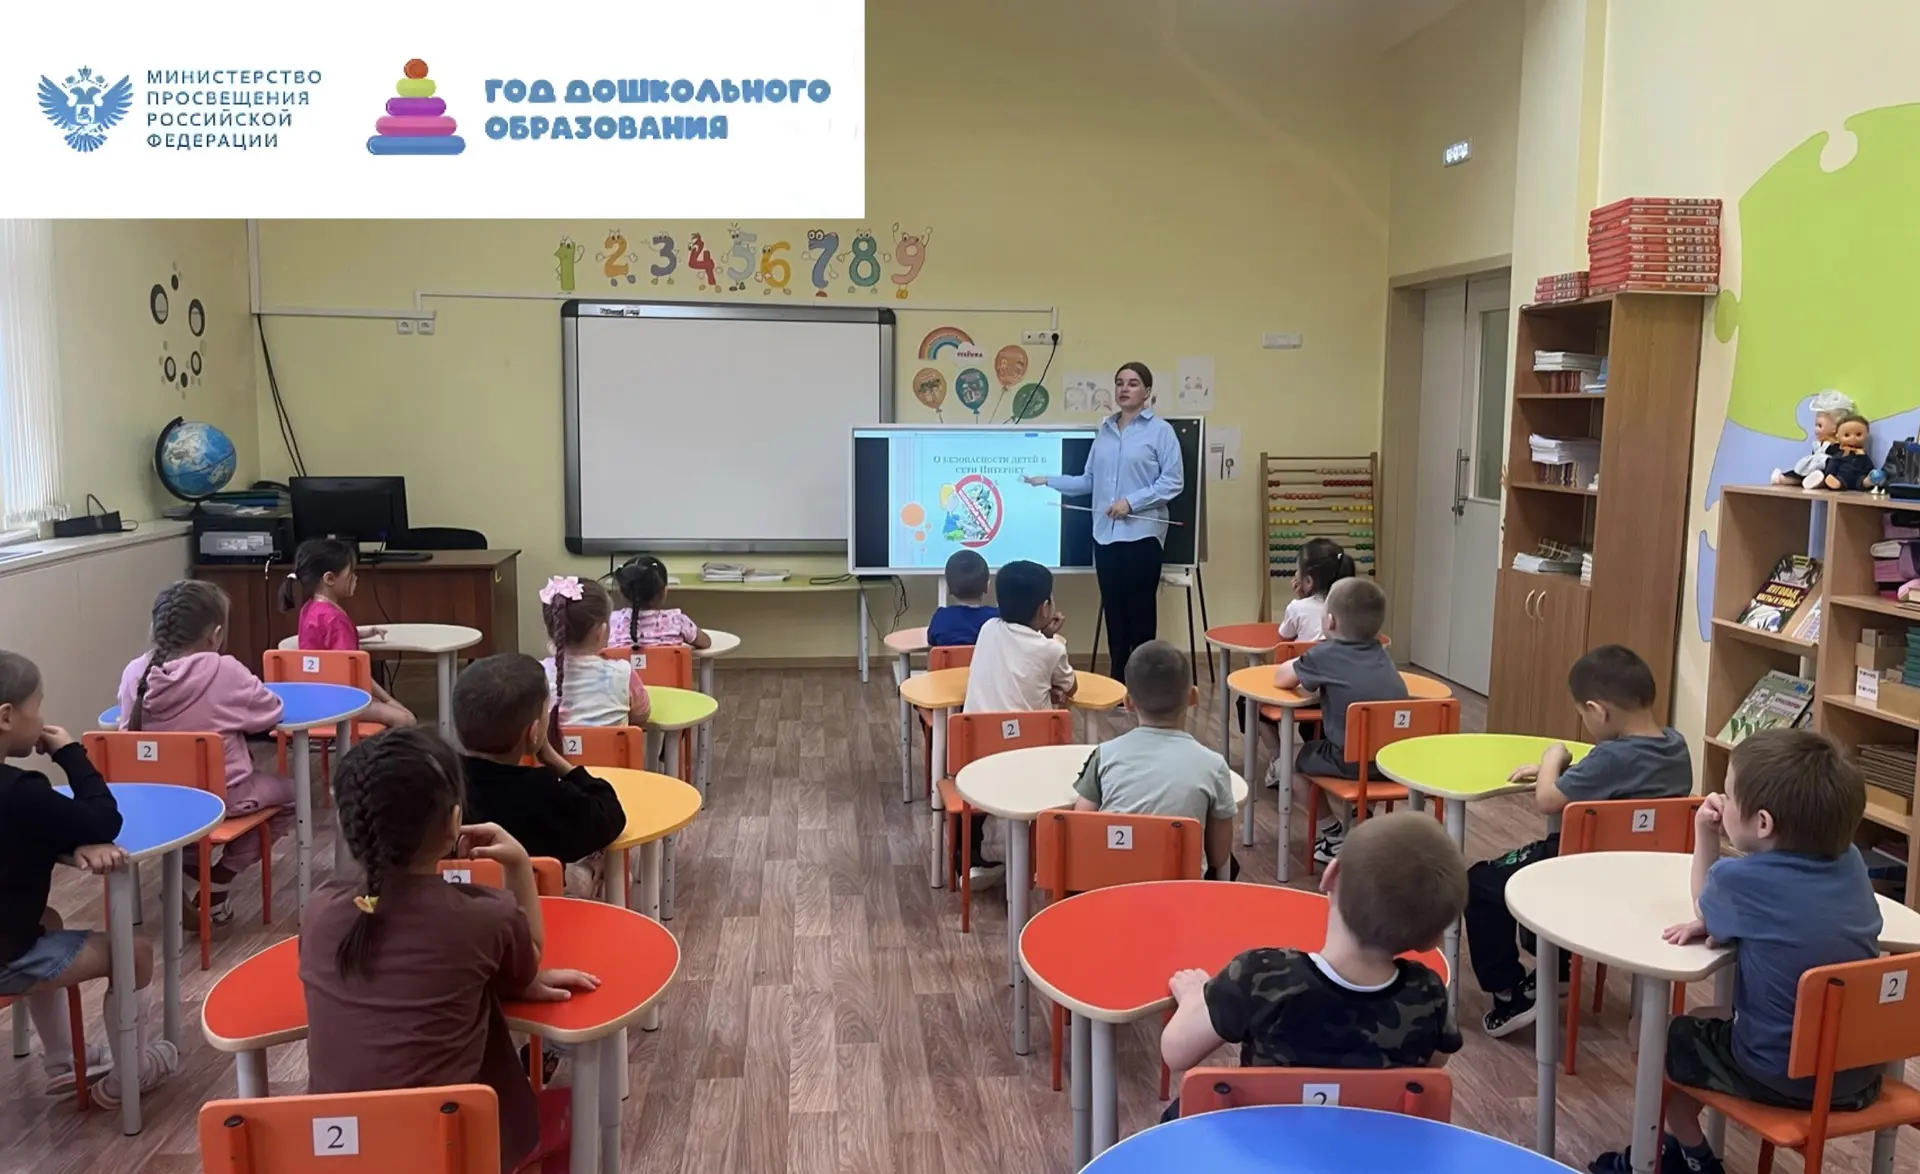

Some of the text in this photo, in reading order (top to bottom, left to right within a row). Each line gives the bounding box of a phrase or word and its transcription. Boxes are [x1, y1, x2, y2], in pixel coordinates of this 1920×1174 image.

[554, 229, 926, 291] 1 2 3 4 5 6 7 8 9
[307, 659, 315, 670] 2
[635, 657, 642, 668] 2
[1399, 713, 1406, 725] 2
[1007, 724, 1015, 736] 2
[143, 745, 152, 758] 2
[568, 739, 577, 752] 2
[1638, 813, 1648, 829] 2
[1115, 830, 1125, 846] 2
[1887, 978, 1899, 998] 2
[328, 1126, 345, 1149] 2
